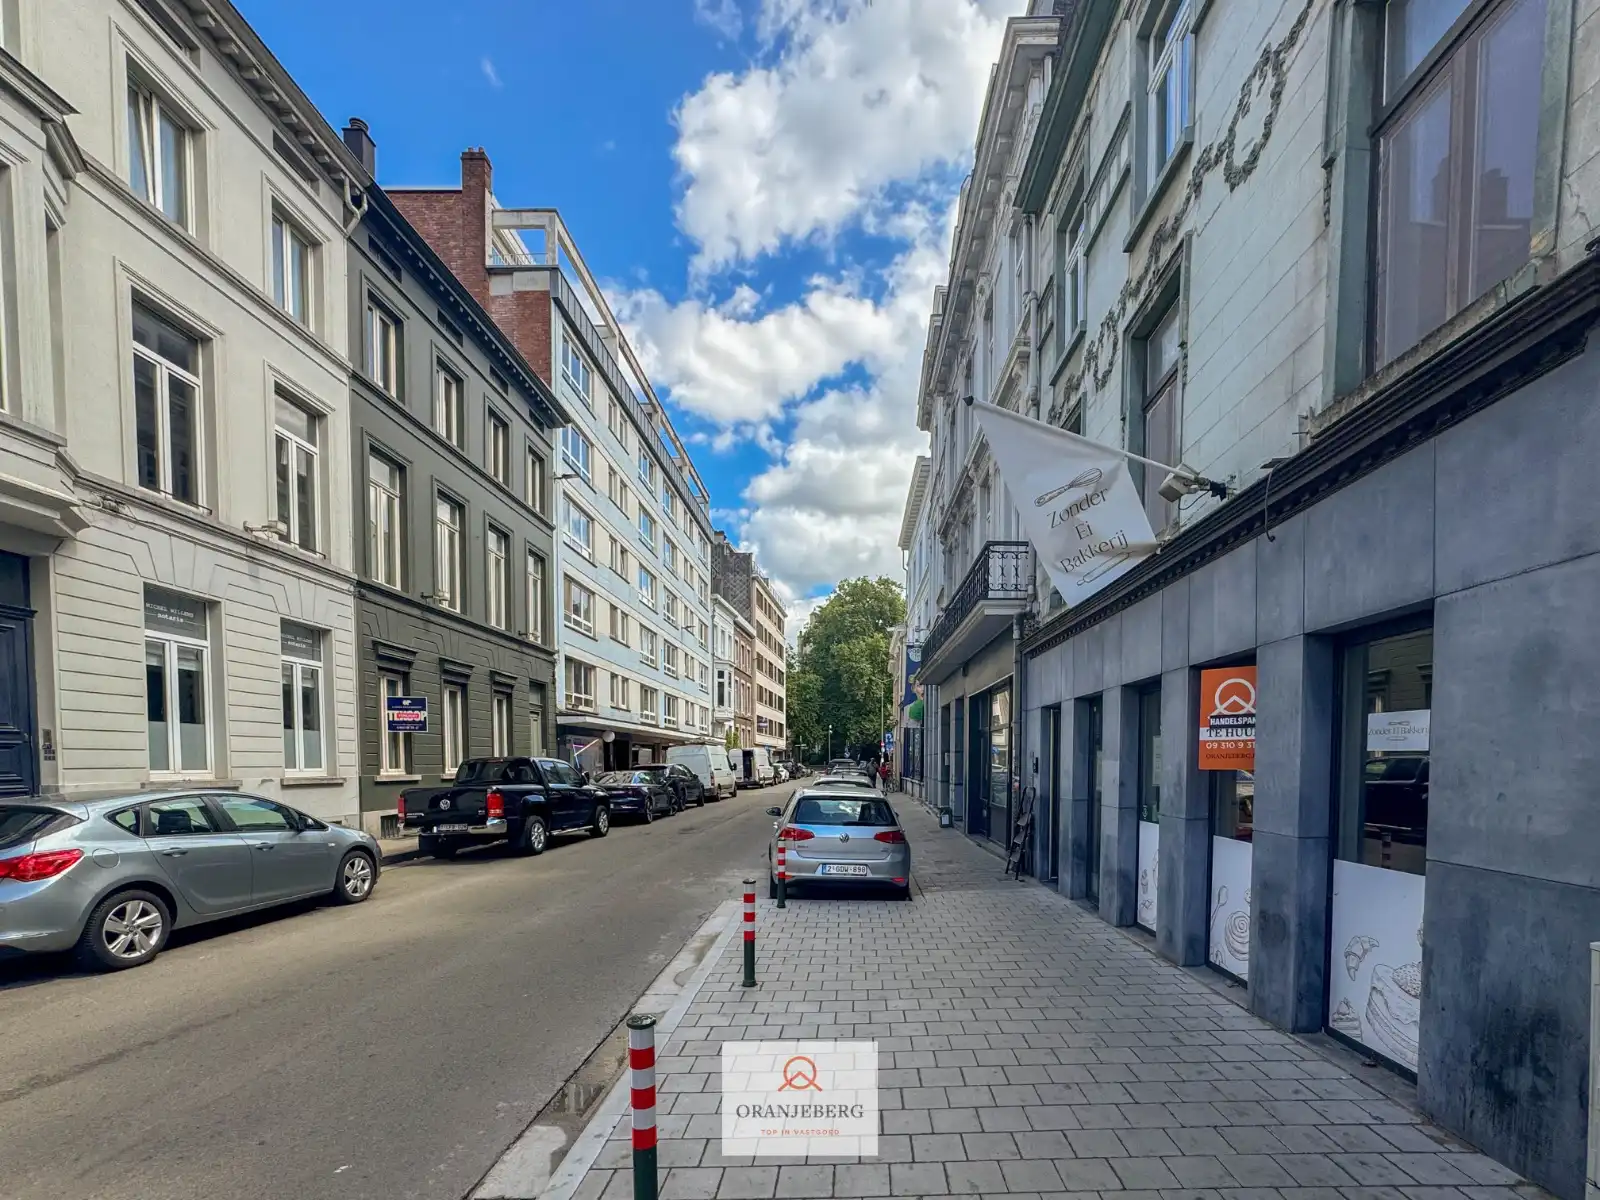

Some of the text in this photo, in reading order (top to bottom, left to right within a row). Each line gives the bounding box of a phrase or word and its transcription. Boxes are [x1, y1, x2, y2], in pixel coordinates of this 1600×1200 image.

[1047, 488, 1109, 529] Zonder
[1074, 521, 1094, 540] Ei
[1060, 530, 1129, 573] Bakkerij
[1206, 728, 1222, 737] TE
[1220, 741, 1235, 749] 310
